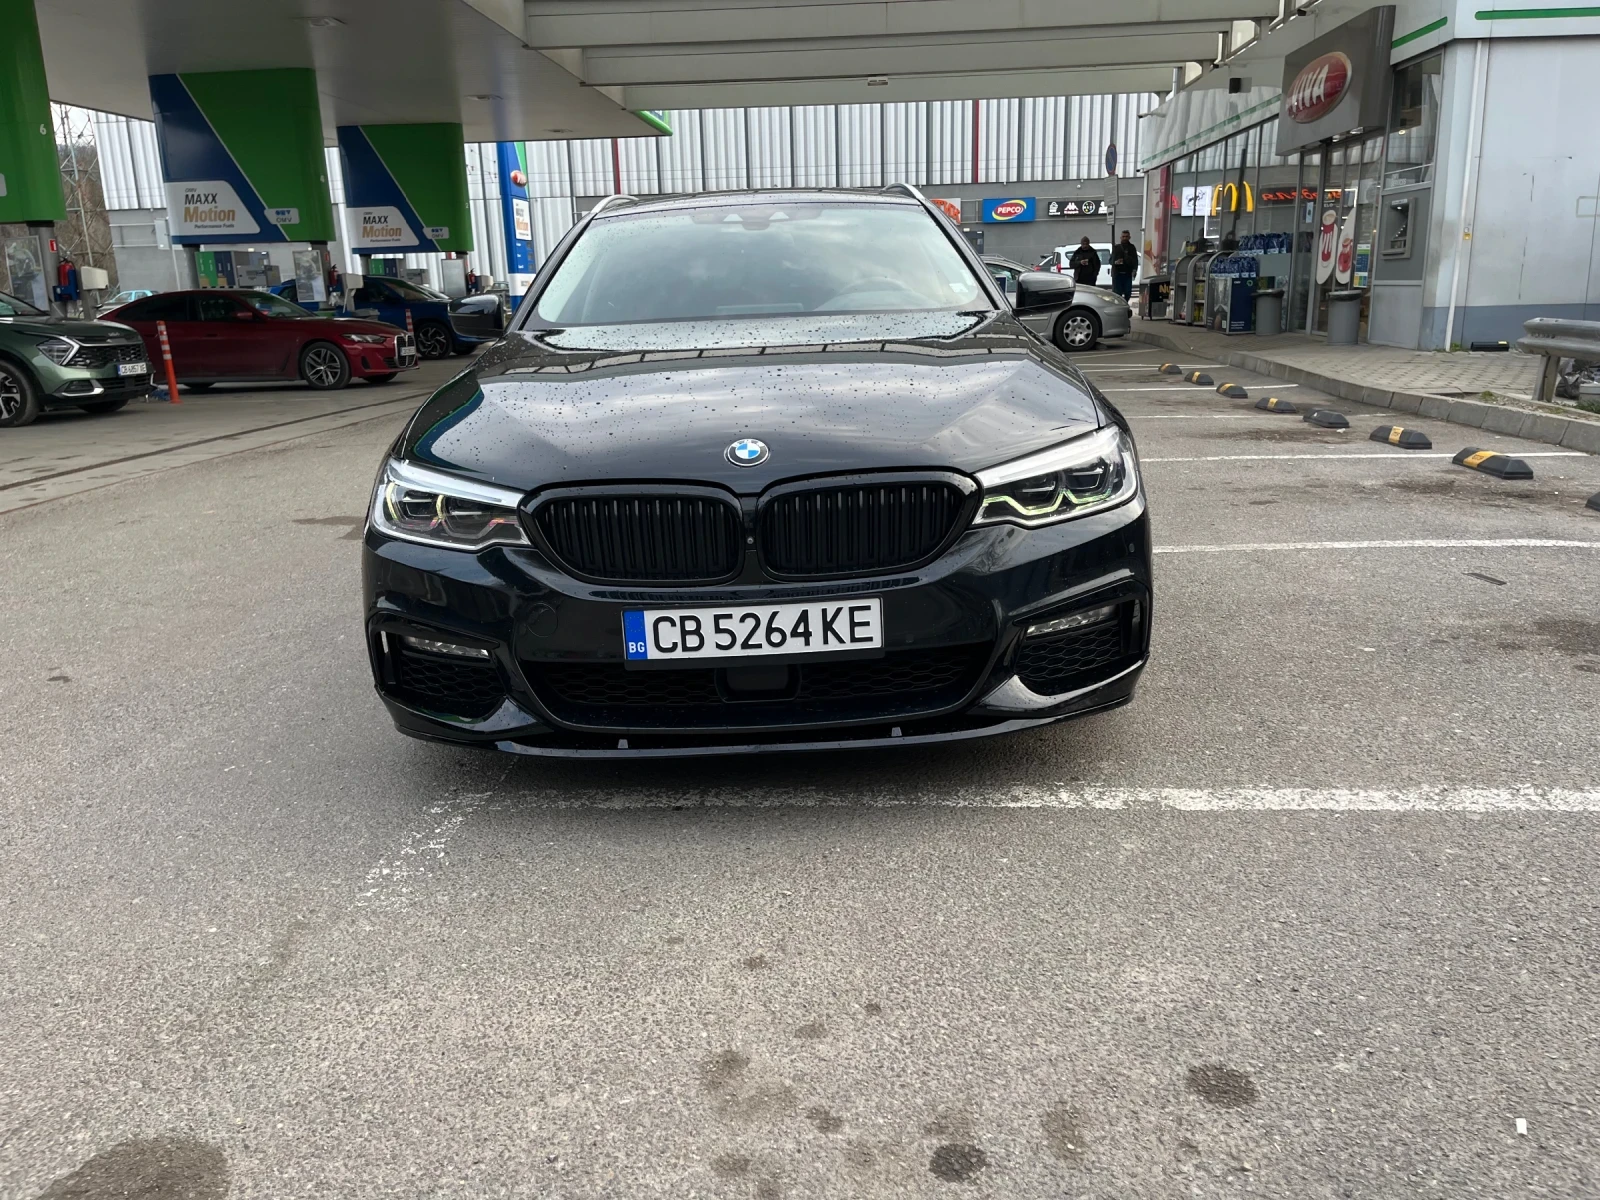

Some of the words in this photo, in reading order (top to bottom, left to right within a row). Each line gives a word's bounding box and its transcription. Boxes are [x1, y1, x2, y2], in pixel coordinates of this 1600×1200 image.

[1290, 64, 1329, 113] VIVA
[40, 124, 46, 135] 6
[184, 193, 218, 205] MAXX
[184, 206, 236, 223] Motion
[997, 206, 1023, 217] PEPCO
[363, 216, 389, 225] MAXX
[362, 225, 402, 238] Motion
[629, 641, 645, 653] BG
